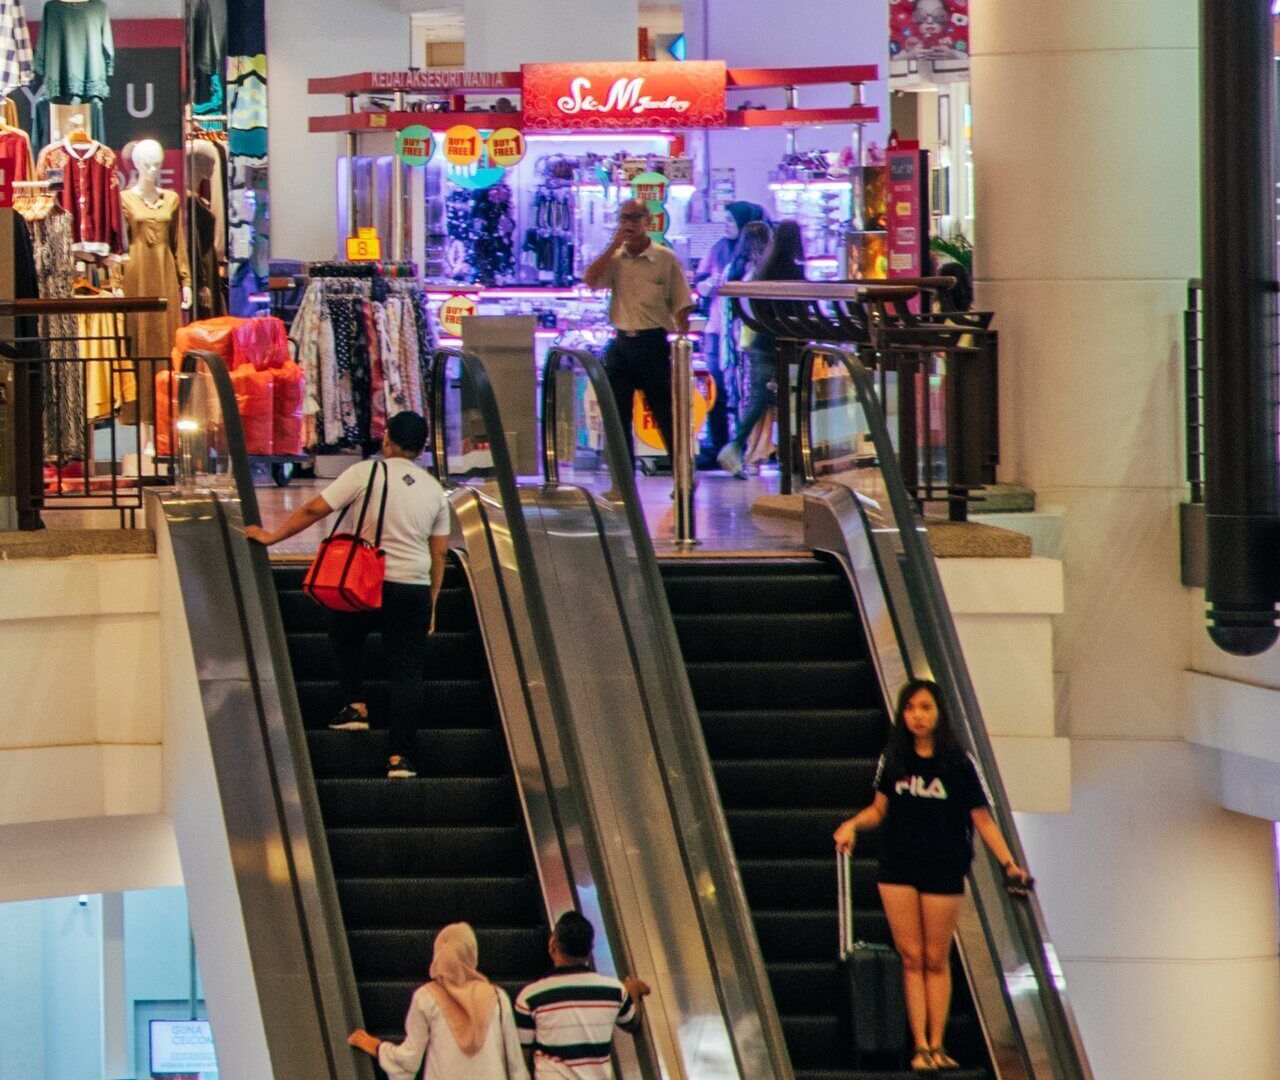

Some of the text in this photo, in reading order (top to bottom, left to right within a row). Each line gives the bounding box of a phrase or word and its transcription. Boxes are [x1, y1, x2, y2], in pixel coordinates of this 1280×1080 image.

[371, 71, 503, 88] KEDAI AKSESORI WANITA
[402, 137, 431, 157] BUY 1
[402, 147, 423, 156] FREE
[448, 136, 476, 156] BUY 1
[448, 147, 468, 156] FREE
[493, 135, 522, 156] BUY 1
[493, 148, 515, 157] FREE
[357, 241, 368, 256] 8
[446, 306, 463, 315] BUY
[894, 774, 948, 800] FILA
